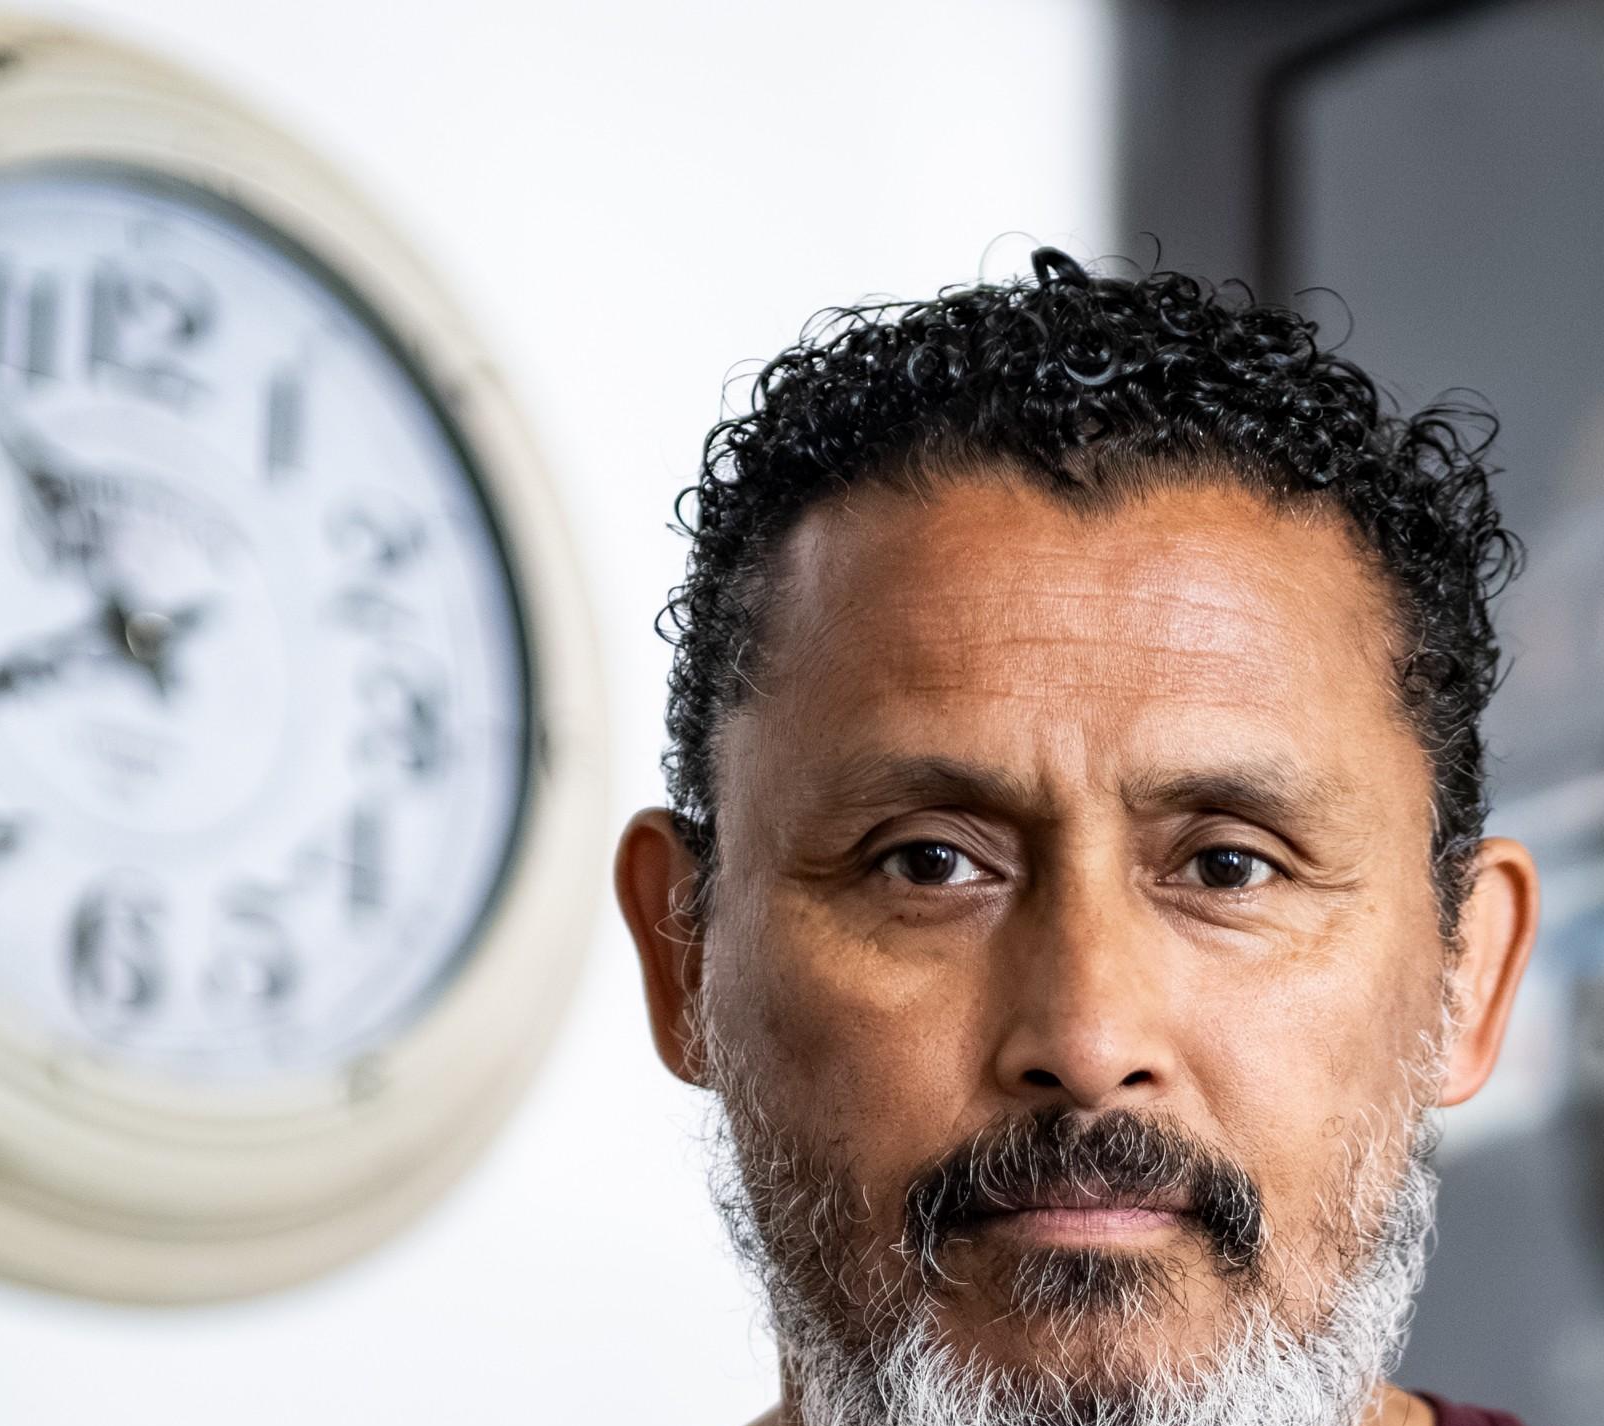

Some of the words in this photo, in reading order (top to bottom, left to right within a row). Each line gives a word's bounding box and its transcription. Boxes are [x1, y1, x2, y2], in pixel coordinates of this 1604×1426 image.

[88, 257, 214, 399] 12
[264, 362, 306, 483] 1
[328, 493, 426, 631] 2
[66, 873, 164, 1035] 6
[208, 883, 298, 1015] 5
